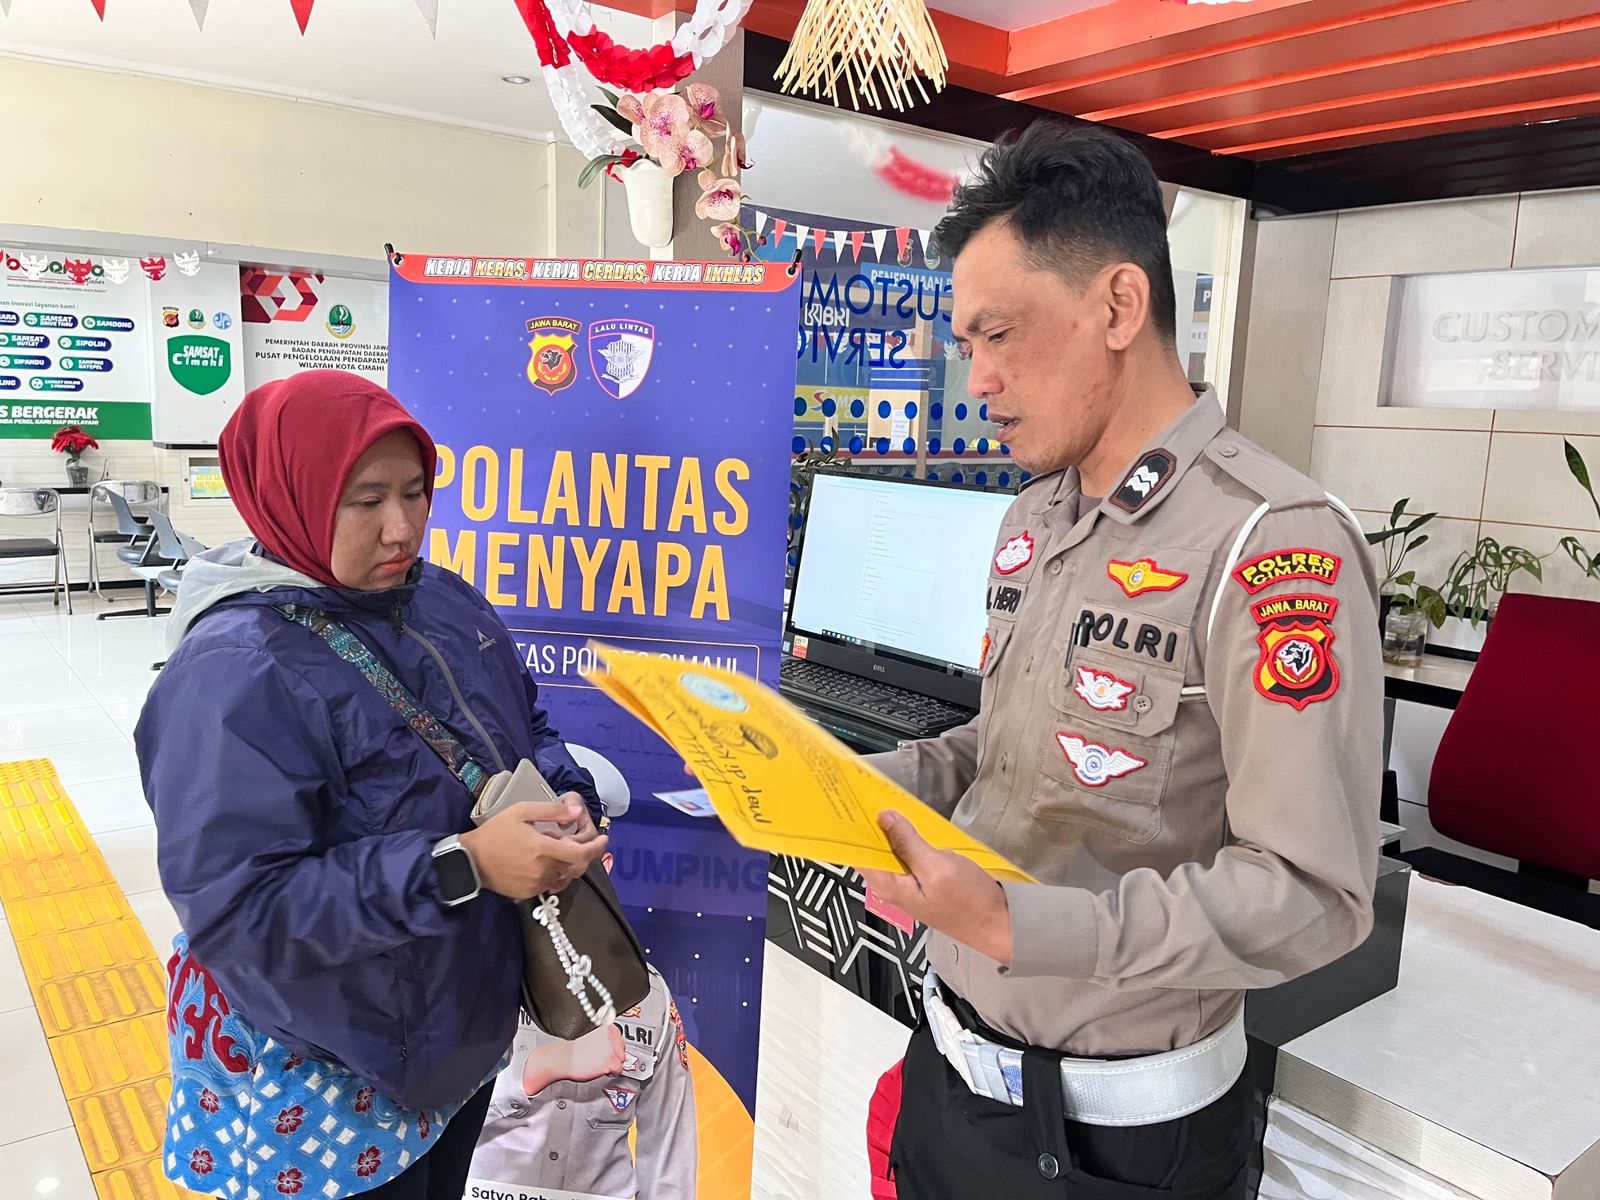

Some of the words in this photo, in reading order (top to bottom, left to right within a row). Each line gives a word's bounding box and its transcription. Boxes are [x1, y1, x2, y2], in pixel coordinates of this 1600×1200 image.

[424, 258, 472, 277] KERJA
[474, 260, 528, 279] KERAS,
[532, 261, 579, 279] KERJA
[582, 262, 650, 284] CERDAS,
[651, 264, 701, 282] KERJA
[703, 264, 765, 284] IKHLAS
[96, 320, 132, 328] SAMDONG
[530, 319, 553, 330] JAWA
[552, 319, 578, 331] BARAT
[823, 306, 850, 327] BRI
[595, 324, 616, 333] LALU
[620, 324, 649, 335] LINTAS
[183, 345, 220, 359] SAMSAT
[283, 353, 340, 362] PENGELOLAAN
[12, 406, 98, 419] BERGERAK
[428, 444, 750, 536] POLANTAS
[429, 528, 731, 621] MENYAPA
[1241, 552, 1335, 582] POLRES
[1252, 564, 1330, 585] CIMAHI
[1260, 600, 1291, 617] JAWA
[1295, 599, 1330, 614] BARAT
[1078, 609, 1177, 662] POLRI
[872, 664, 886, 673] DELL
